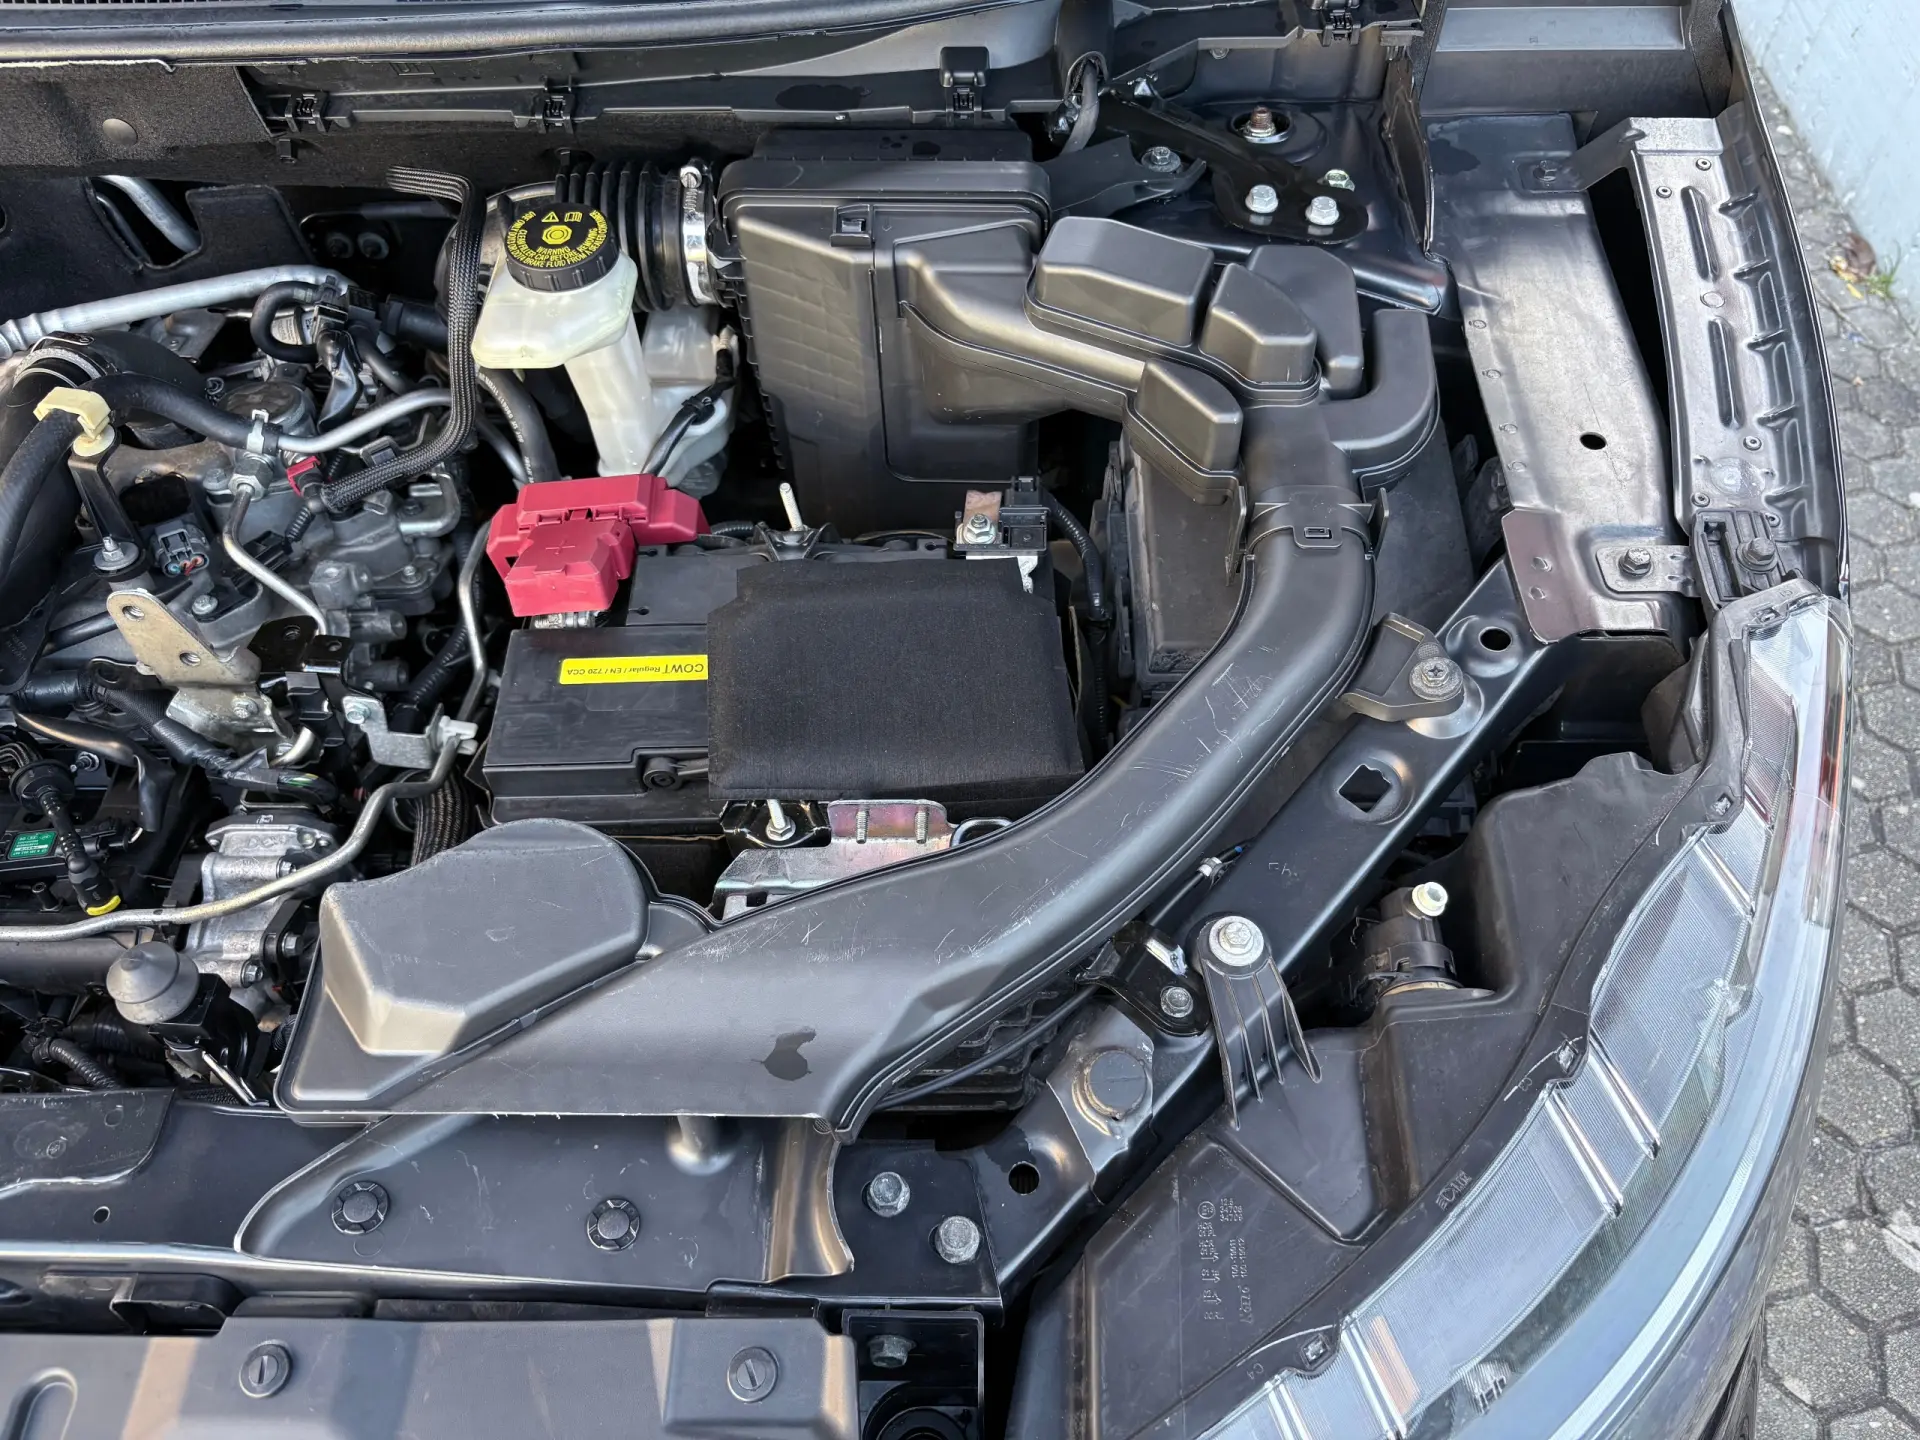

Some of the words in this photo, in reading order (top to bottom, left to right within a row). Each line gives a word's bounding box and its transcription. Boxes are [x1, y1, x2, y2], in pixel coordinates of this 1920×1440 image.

[522, 211, 536, 222] USE
[518, 244, 537, 258] FILLER
[550, 250, 581, 261] BEFORE
[536, 246, 570, 256] WARNING
[523, 257, 546, 268] BRAKE
[566, 253, 588, 265] FROM
[629, 666, 661, 674] Regular
[664, 663, 704, 674] COWT
